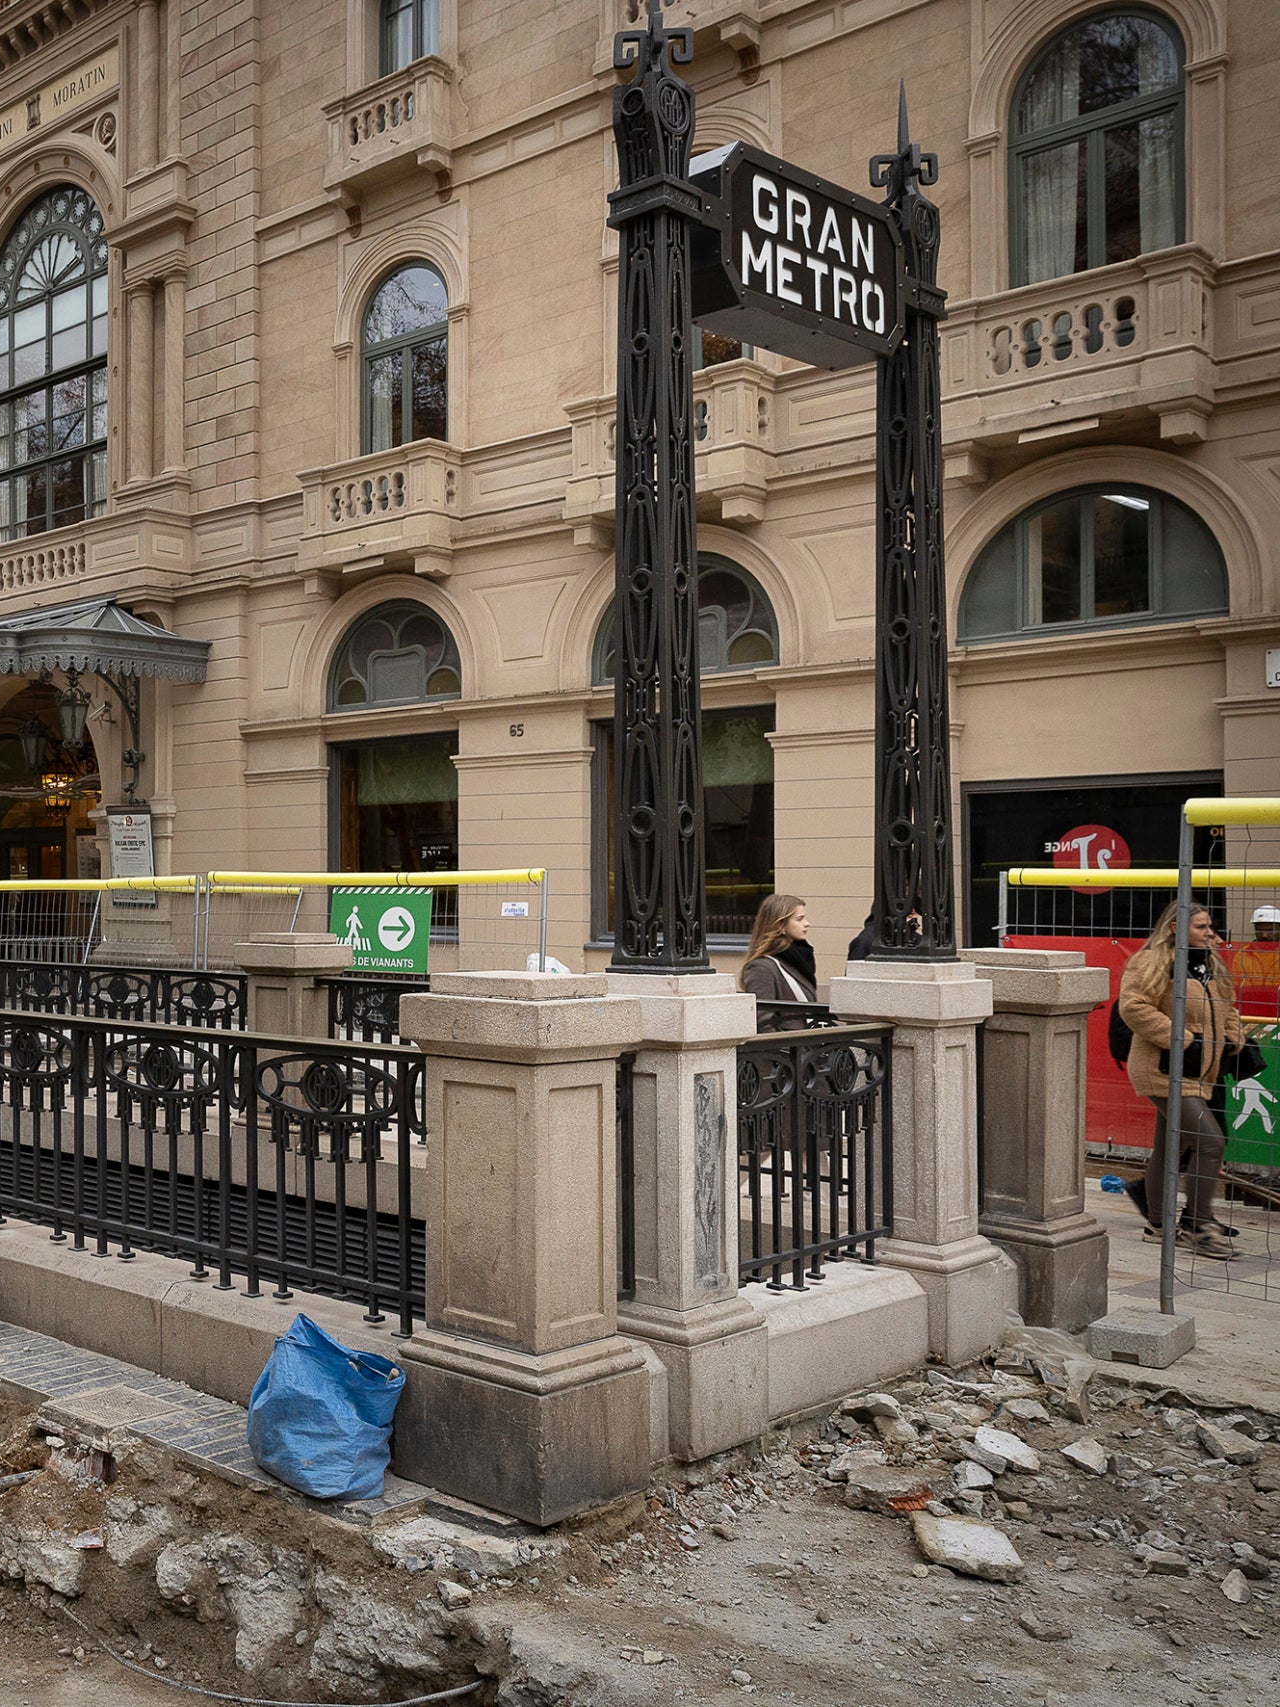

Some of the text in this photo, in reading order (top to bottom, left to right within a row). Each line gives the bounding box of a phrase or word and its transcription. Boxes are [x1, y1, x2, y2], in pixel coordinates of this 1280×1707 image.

[53, 64, 106, 108] MORATIN
[751, 173, 875, 275] GRAN
[741, 230, 885, 335] METRO
[509, 724, 524, 737] 65
[358, 957, 369, 966] DE
[370, 957, 414, 968] VIANANTS
